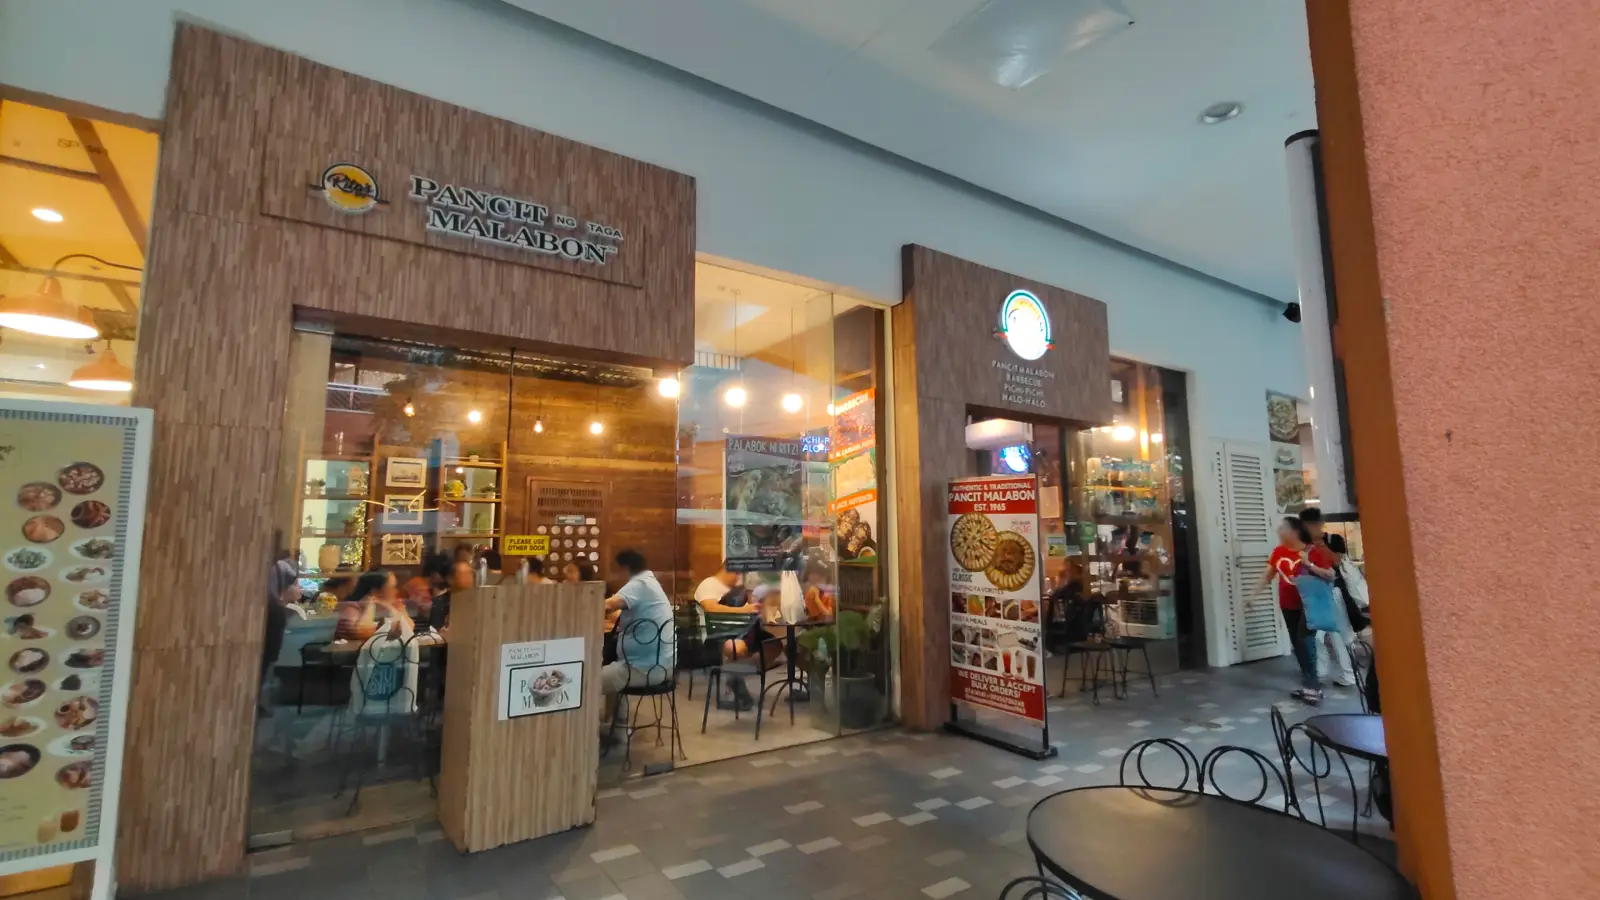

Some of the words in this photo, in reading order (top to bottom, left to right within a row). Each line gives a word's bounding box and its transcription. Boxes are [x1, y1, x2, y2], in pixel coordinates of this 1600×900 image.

[411, 175, 548, 225] PANCIT
[555, 214, 577, 229] NG
[588, 221, 624, 241] TAGA
[427, 207, 608, 265] MALABON
[1001, 393, 1046, 408] HALO-HALO
[727, 438, 766, 453] PALABOK
[952, 484, 982, 492] AUTHENTIC
[990, 482, 1032, 490] TRADITIONAL
[949, 491, 982, 502] PANCIT
[983, 489, 1035, 501] MALABON
[974, 503, 988, 512] EST.
[990, 502, 1006, 511] 1965
[958, 669, 969, 679] WE
[969, 672, 998, 685] DELIVER
[1007, 680, 1036, 694] ACCEPT
[971, 680, 988, 691] BULK
[989, 685, 1021, 698] ORDERS!
